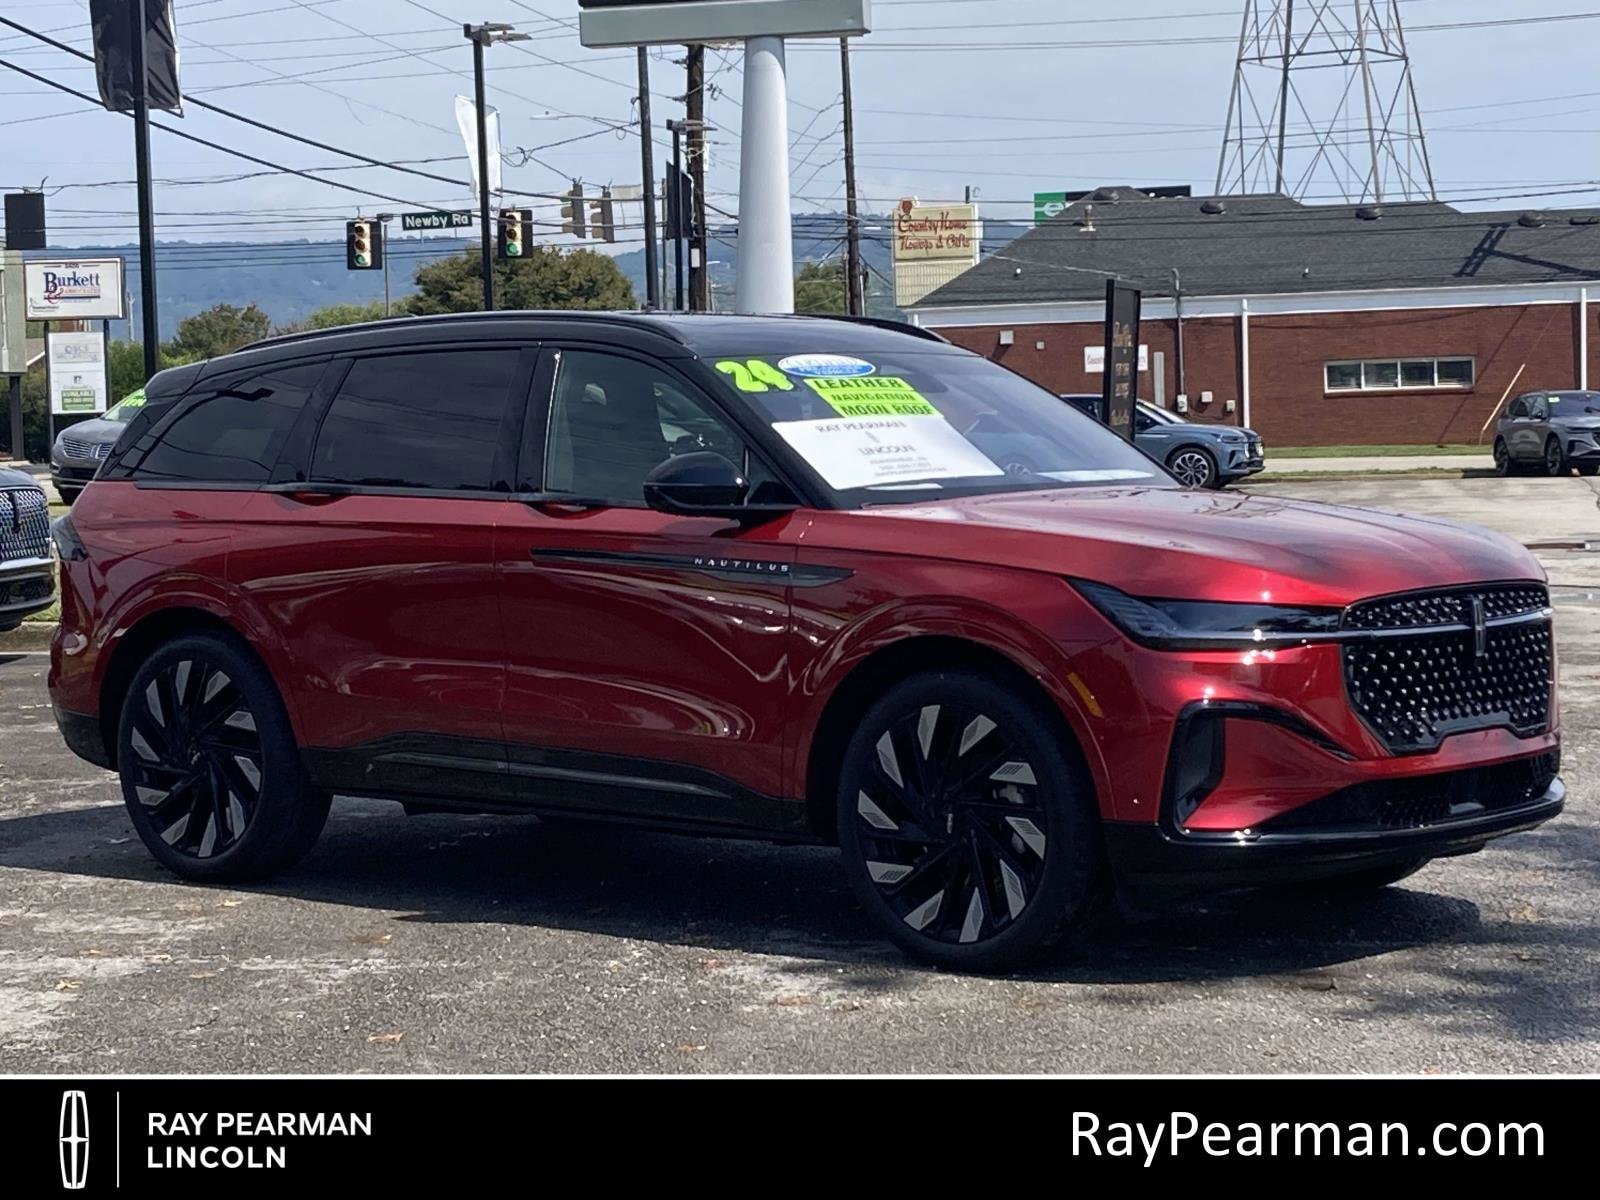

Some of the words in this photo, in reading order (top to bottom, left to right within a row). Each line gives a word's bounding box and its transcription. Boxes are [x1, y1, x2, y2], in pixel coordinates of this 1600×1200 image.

[405, 215, 448, 229] Newby
[43, 271, 100, 293] Burkett
[715, 359, 794, 392] 24
[814, 378, 907, 390] LEATHER
[831, 392, 917, 402] NAVIGATION
[840, 403, 889, 417] MOON
[892, 404, 936, 416] ROOF
[815, 422, 842, 433] RAY
[844, 420, 909, 432] PEARMAN
[857, 443, 917, 456] LINCOLN
[693, 557, 791, 572] NAUTILUS
